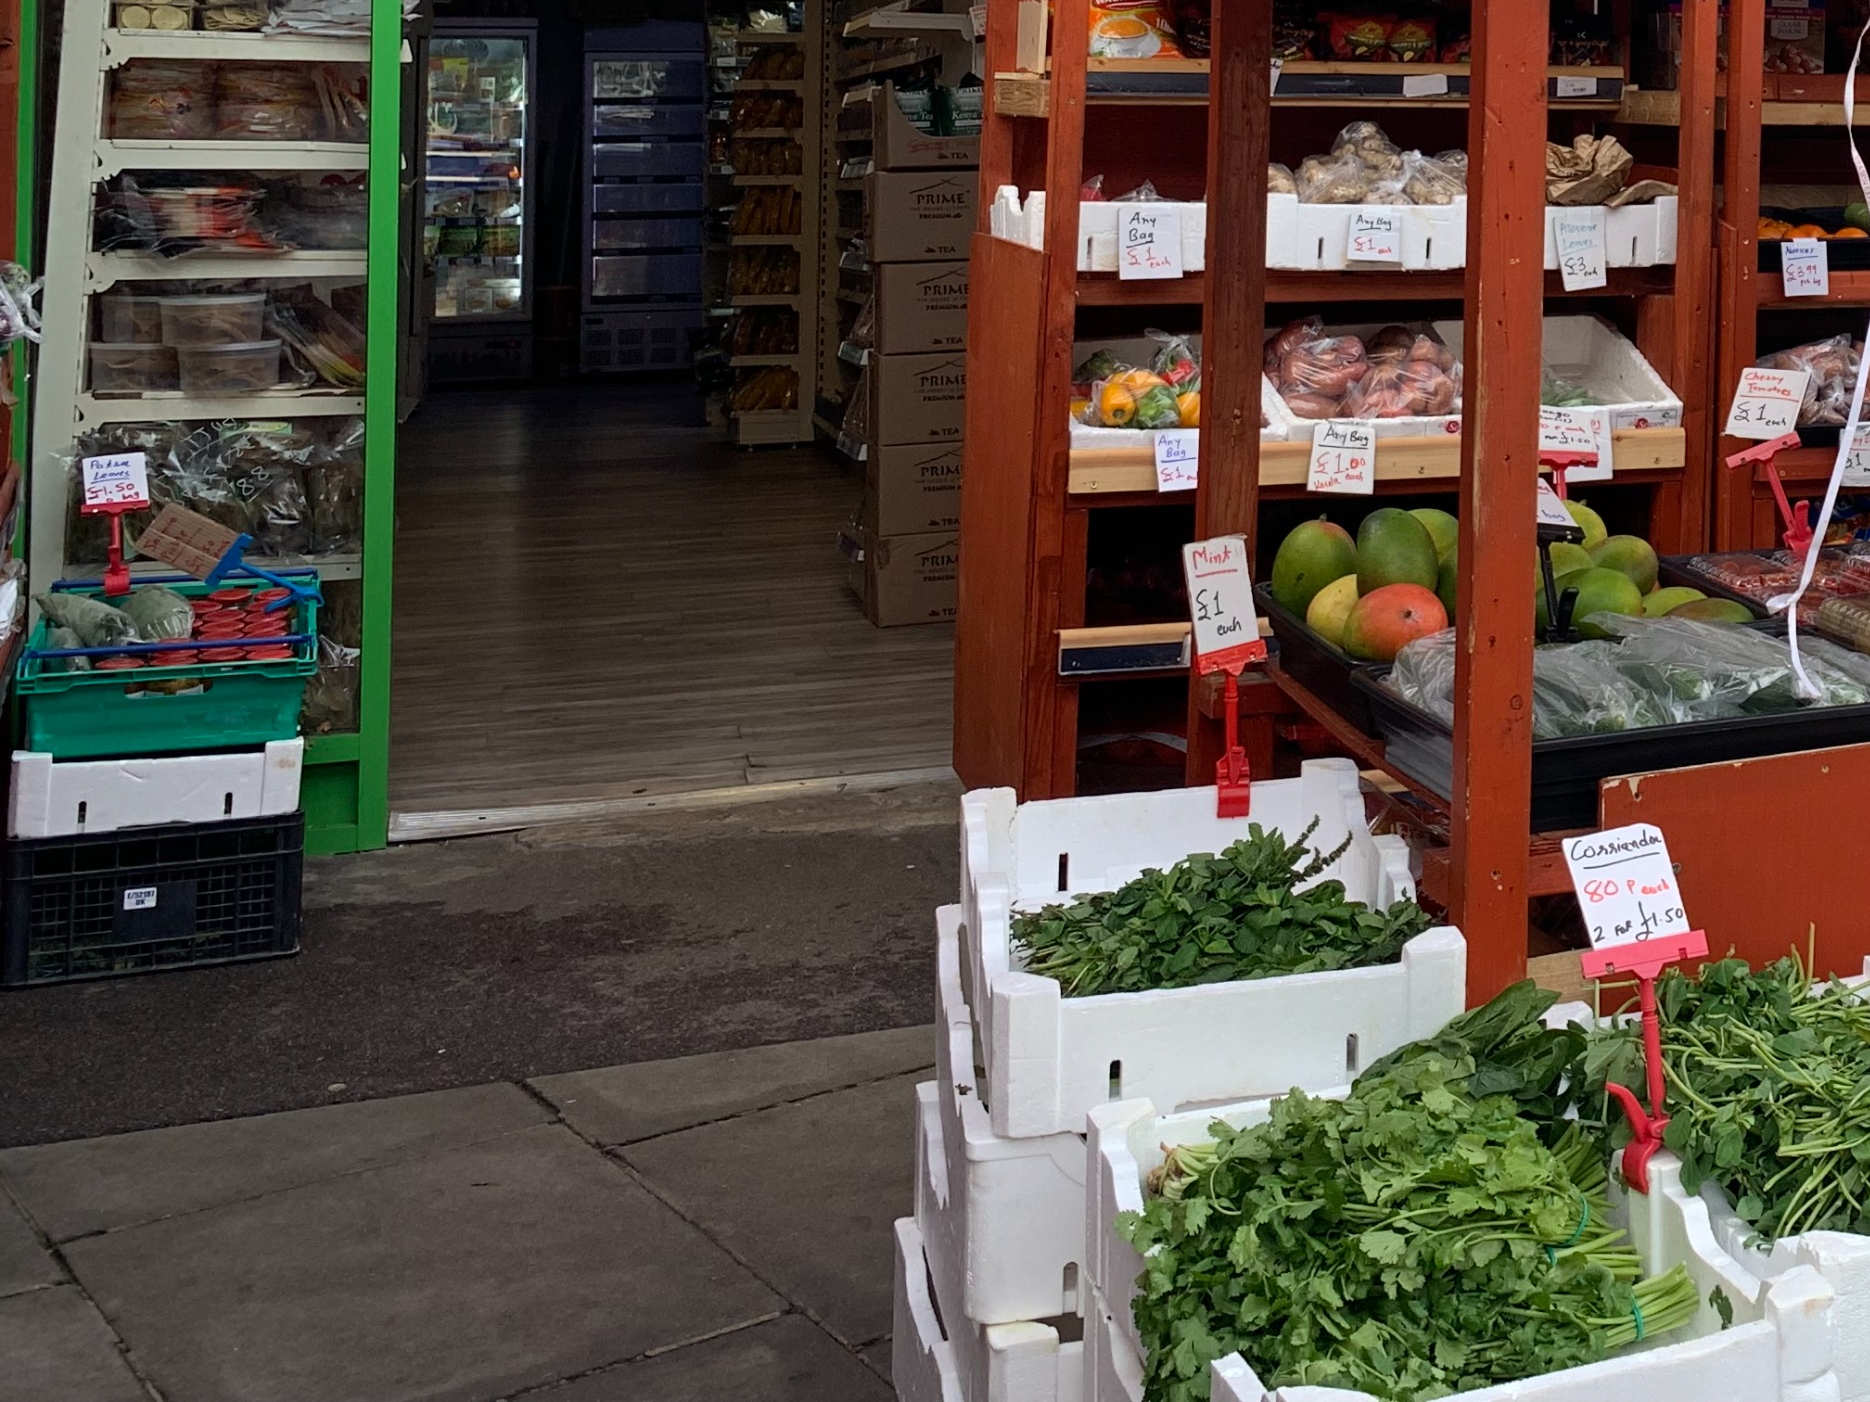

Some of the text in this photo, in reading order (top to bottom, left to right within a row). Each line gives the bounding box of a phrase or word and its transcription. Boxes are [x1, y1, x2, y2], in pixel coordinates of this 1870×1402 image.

[950, 152, 969, 160] TEA
[916, 193, 966, 205] PRIME
[1129, 211, 1157, 228] Any
[1356, 214, 1374, 229] Any
[1128, 227, 1155, 244] Bag
[937, 246, 956, 254] TEA
[1564, 256, 1587, 276] £3
[923, 284, 970, 296] PRIME
[944, 337, 963, 345] TEA
[920, 375, 967, 388] PRIME
[1744, 371, 1785, 385] Cherry
[1748, 382, 1792, 397] Tomatoes
[941, 428, 960, 436] TEA
[1323, 426, 1369, 446] Any Bag
[1157, 434, 1181, 450] Any
[1166, 445, 1187, 458] Bag
[93, 469, 131, 480] Leaves
[921, 465, 962, 478] PRIM
[941, 518, 960, 527] TEA
[1192, 544, 1232, 570] Mint
[1196, 588, 1224, 621] £1
[1216, 616, 1242, 636] each
[1583, 879, 1619, 903] 80
[1593, 925, 1606, 943] 2
[1635, 900, 1684, 943] £1.50
